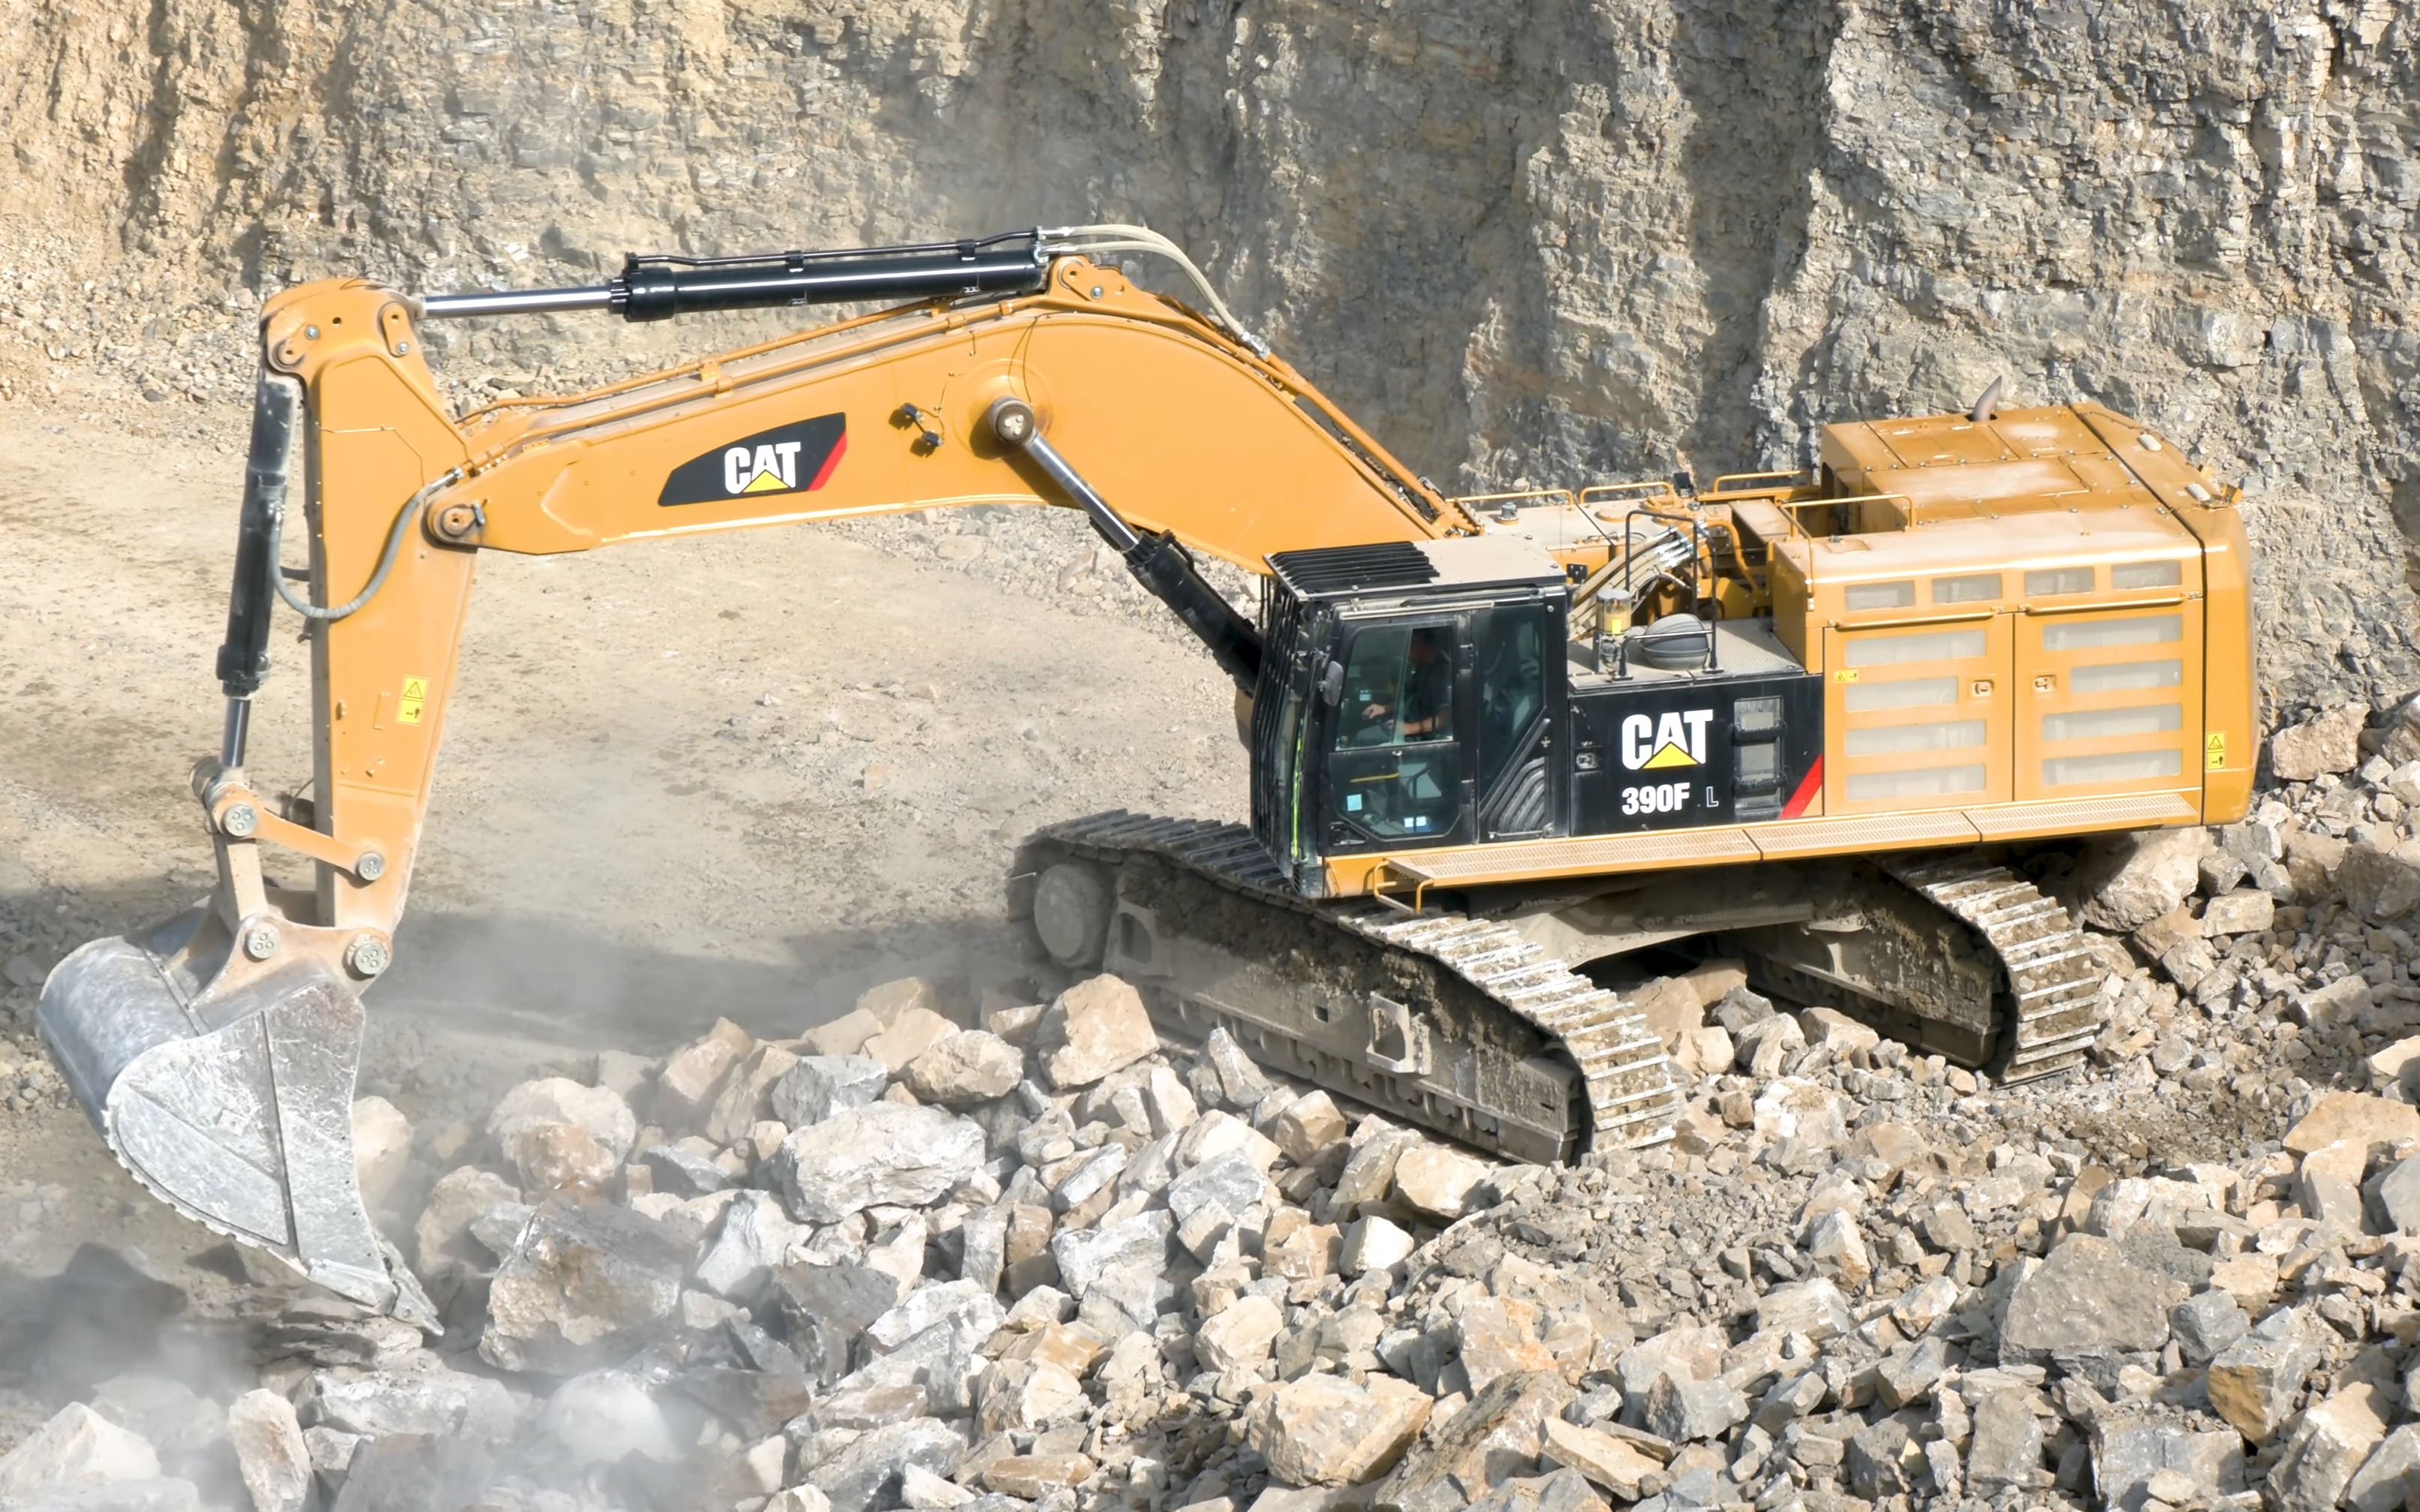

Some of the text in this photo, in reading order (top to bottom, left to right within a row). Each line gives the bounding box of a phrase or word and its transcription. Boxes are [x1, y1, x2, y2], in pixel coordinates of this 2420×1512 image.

[724, 441, 801, 494] CAT
[1622, 709, 1714, 770] CAT
[1622, 782, 1719, 815] 390F L
